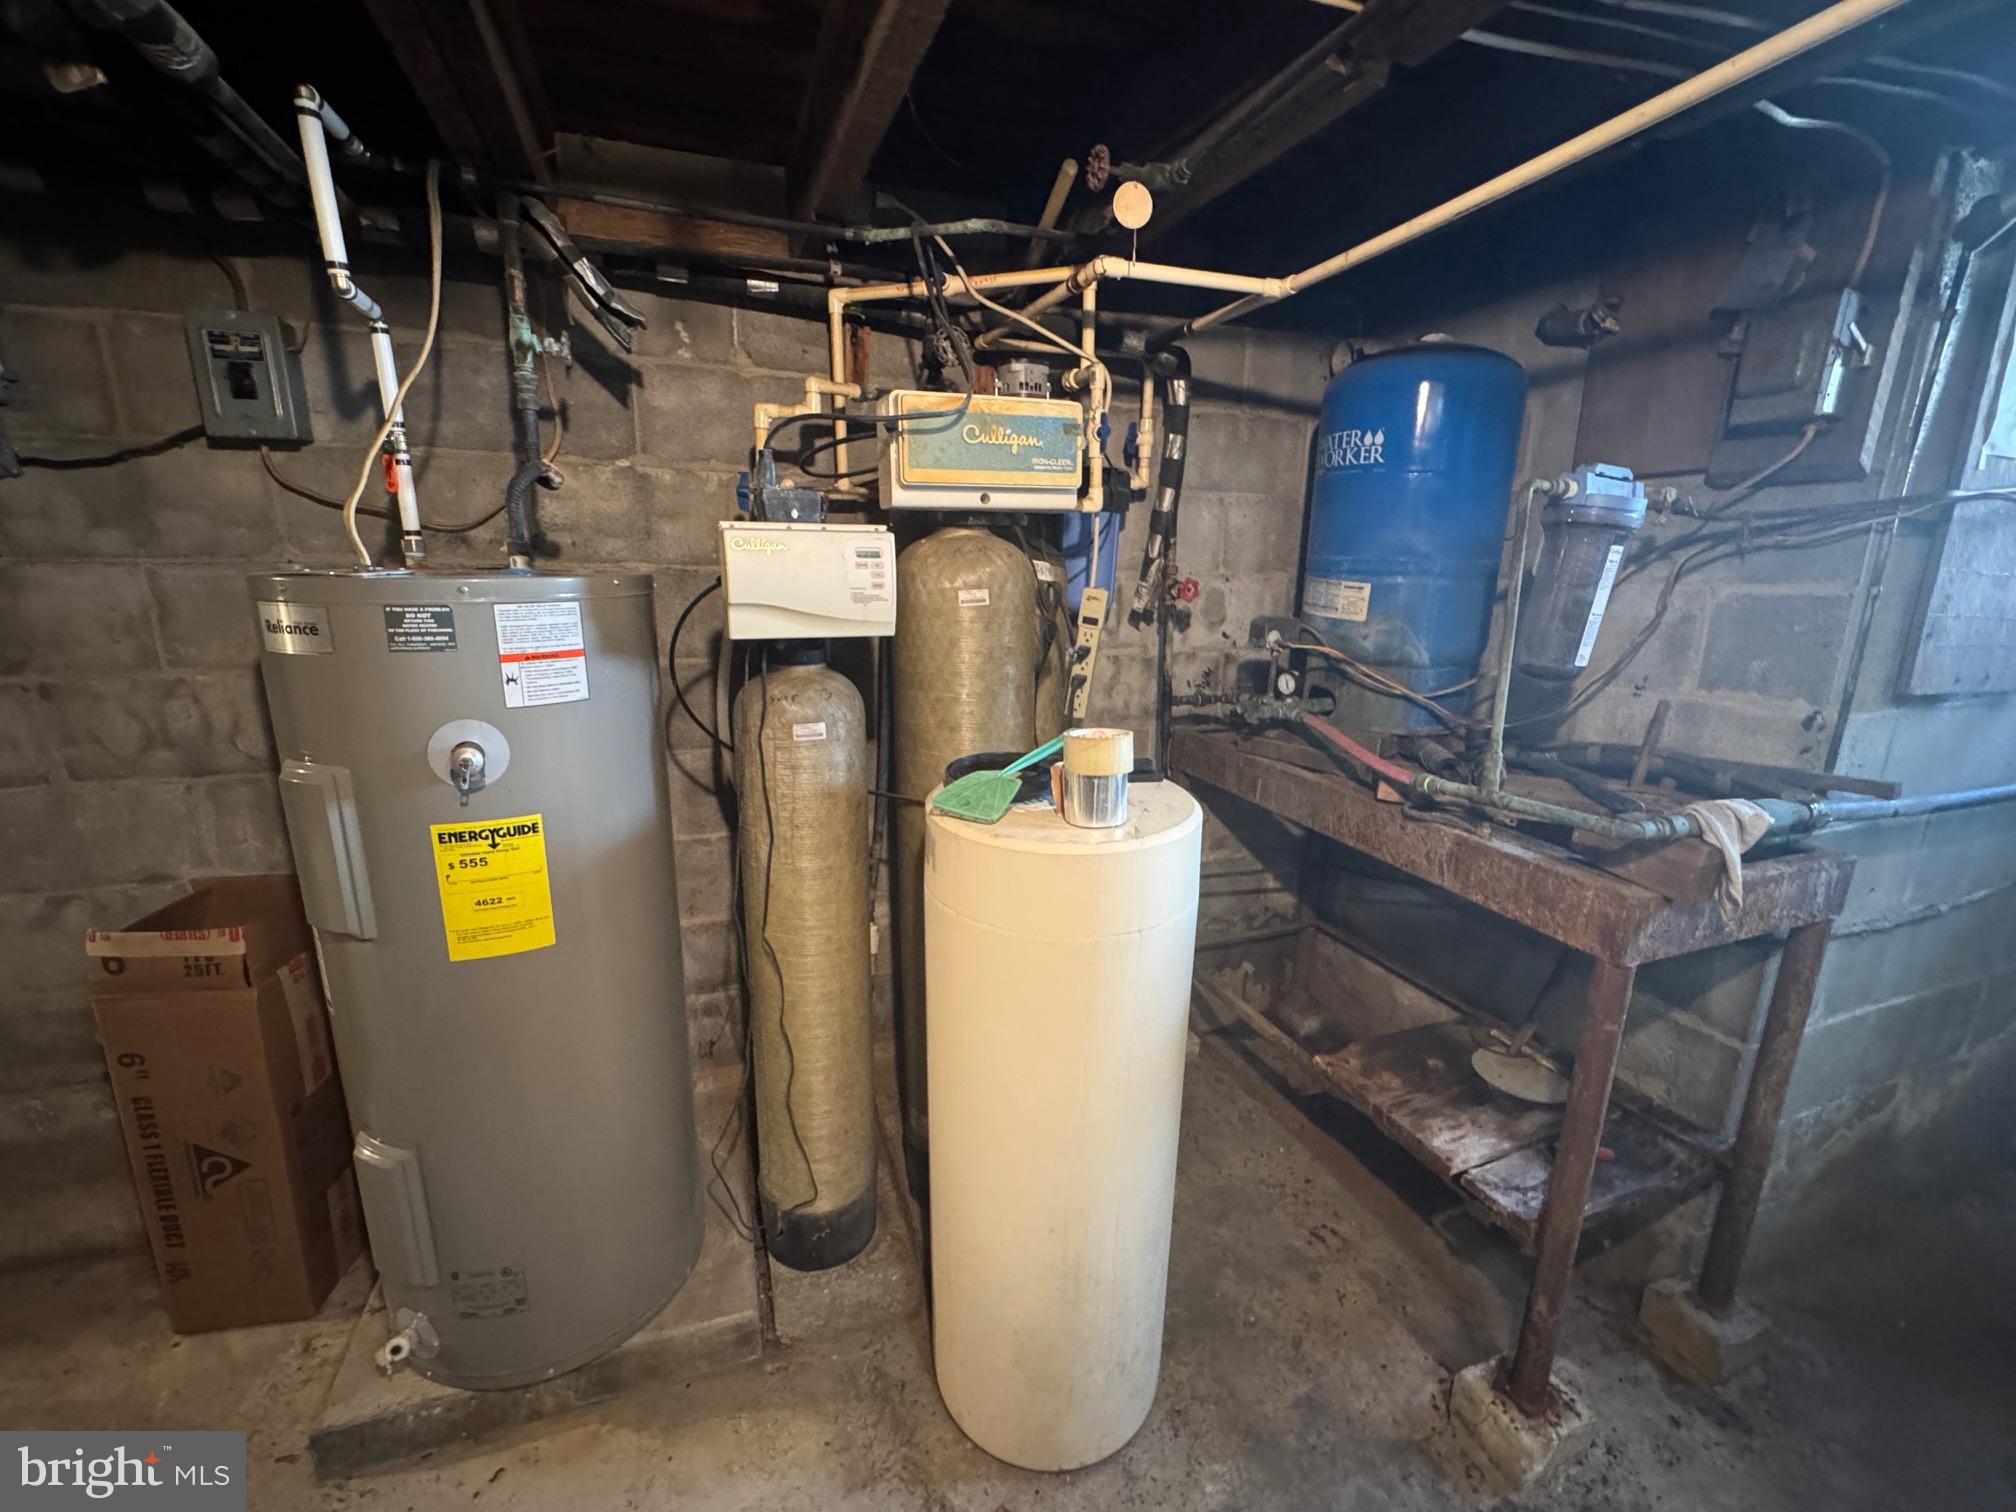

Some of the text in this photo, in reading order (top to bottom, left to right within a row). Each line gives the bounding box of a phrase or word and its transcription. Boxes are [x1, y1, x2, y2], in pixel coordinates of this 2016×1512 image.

[963, 424, 1043, 454] Culligan
[731, 537, 790, 557] Culligan
[265, 619, 320, 636] Reliance
[437, 822, 540, 845] ENERGYGUIDE
[459, 857, 489, 869] 555
[474, 897, 503, 907] 4622
[132, 1096, 160, 1139] CLASS
[145, 1153, 177, 1212] FLEXIBLE
[159, 1213, 185, 1248] DUCT
